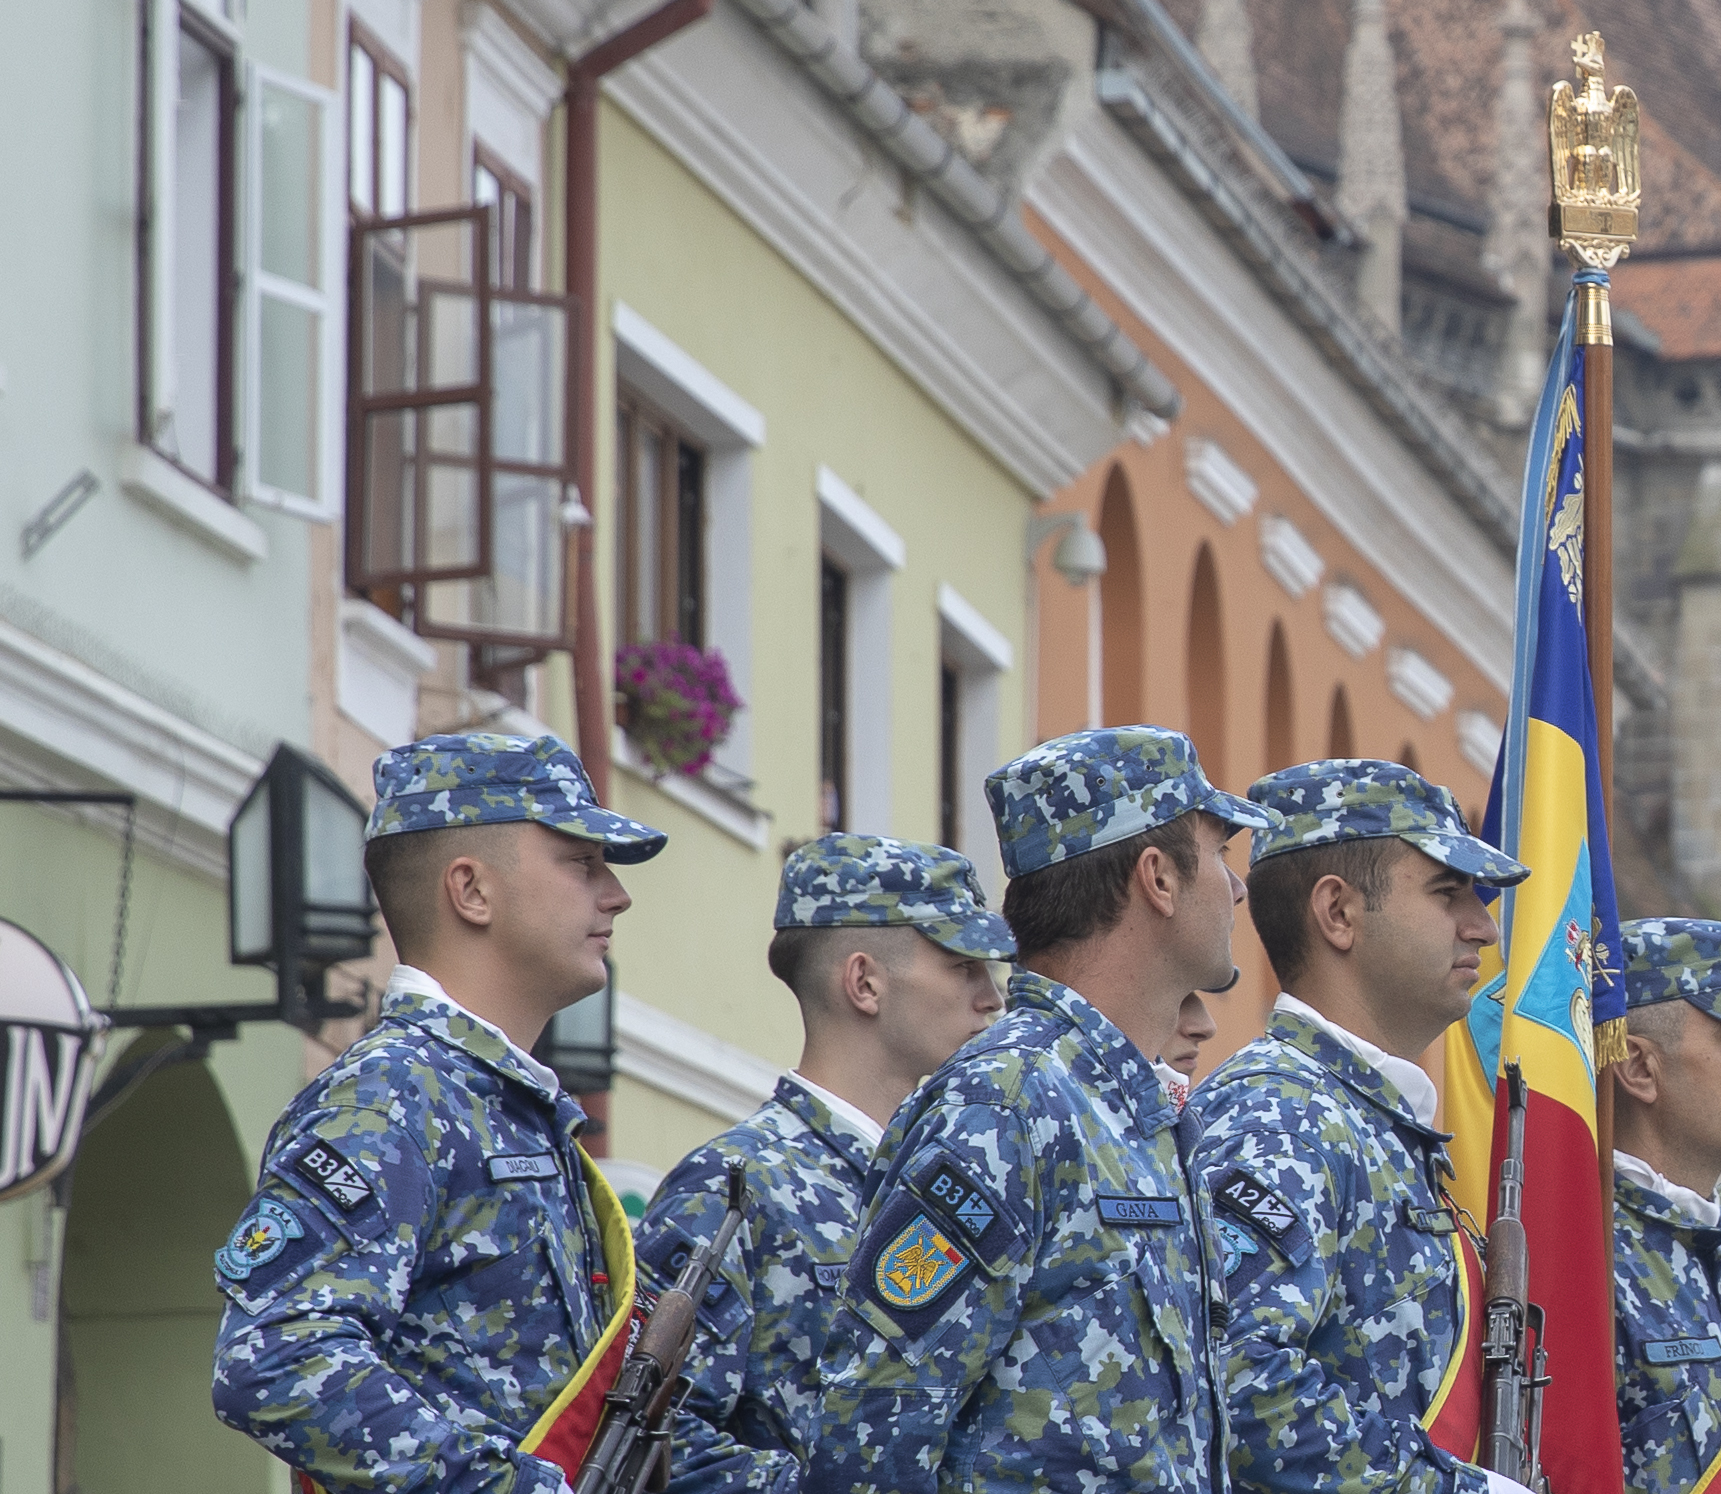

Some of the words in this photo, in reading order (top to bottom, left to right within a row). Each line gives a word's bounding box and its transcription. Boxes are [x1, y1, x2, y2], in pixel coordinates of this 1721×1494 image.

[303, 1148, 338, 1176] B3
[930, 1173, 964, 1205] B3
[1225, 1180, 1260, 1207] A2
[1115, 1202, 1159, 1218] GAVA
